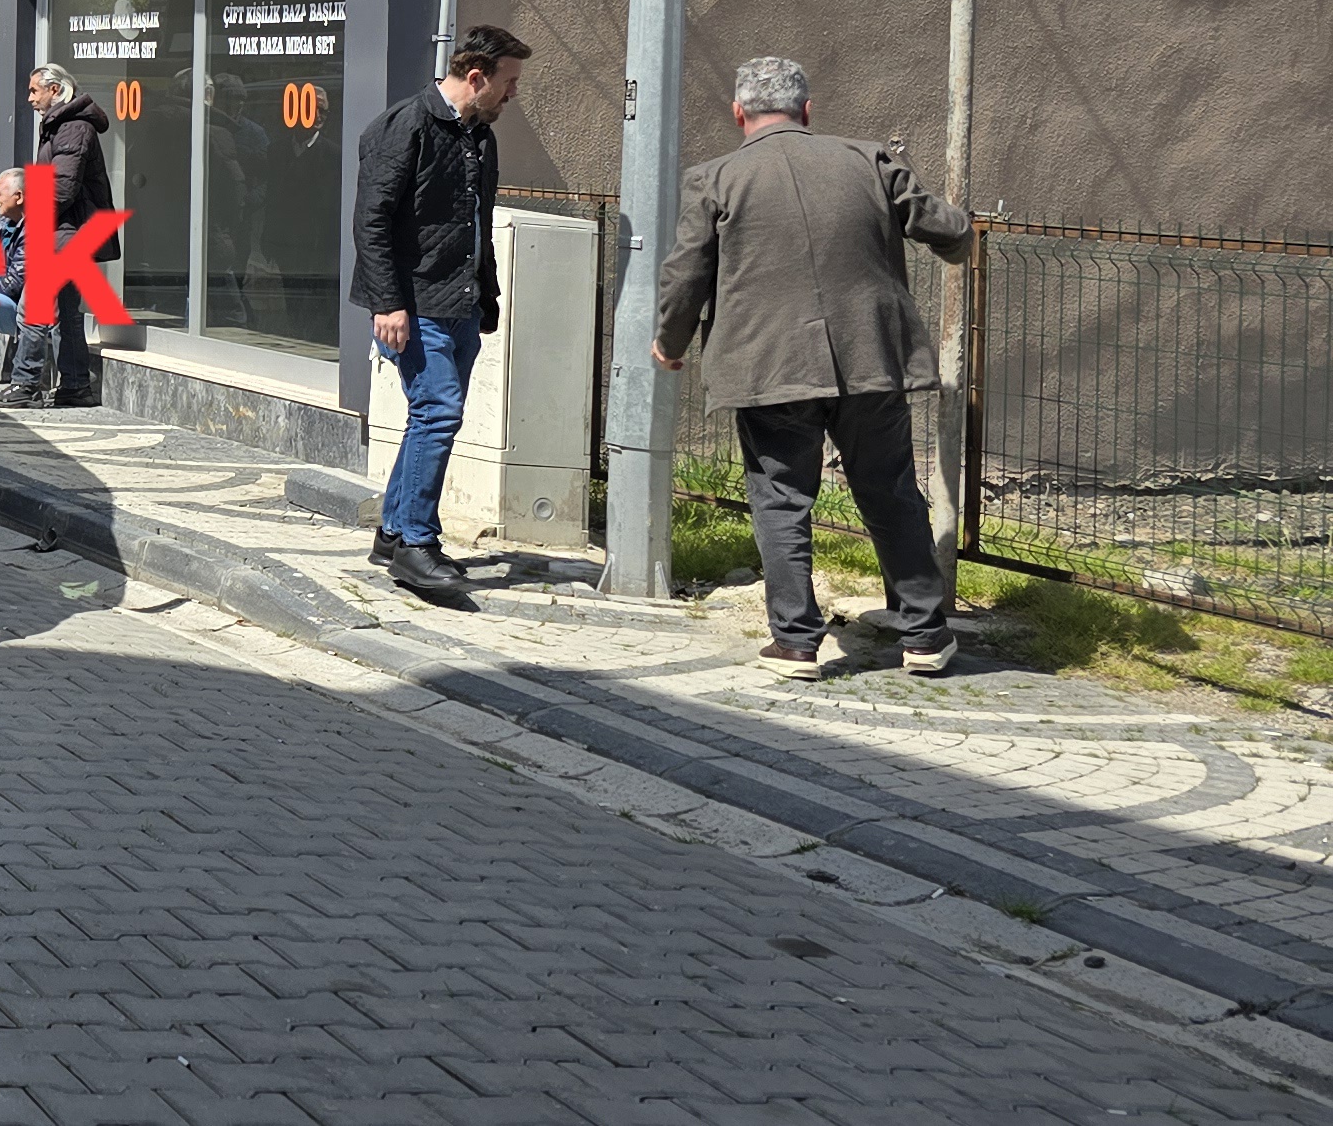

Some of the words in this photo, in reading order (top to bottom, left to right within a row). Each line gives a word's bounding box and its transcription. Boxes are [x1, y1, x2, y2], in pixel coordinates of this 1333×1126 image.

[112, 14, 131, 30] BAZA
[131, 11, 160, 33] BAŞLIK
[223, 2, 245, 28] ÇİFT
[245, 0, 281, 28] KİŞİLİK
[282, 4, 307, 23] BAZA
[309, 1, 347, 26] BAŞLIK
[73, 42, 98, 59] YATAK
[98, 41, 117, 59] BAZA
[117, 41, 141, 59] MEGA
[141, 41, 157, 59] SET
[228, 36, 259, 55] YATAK
[259, 36, 285, 54] BAZA
[285, 36, 313, 54] MEGA
[315, 36, 336, 54] SET
[115, 80, 141, 121] 00
[283, 82, 317, 128] 00
